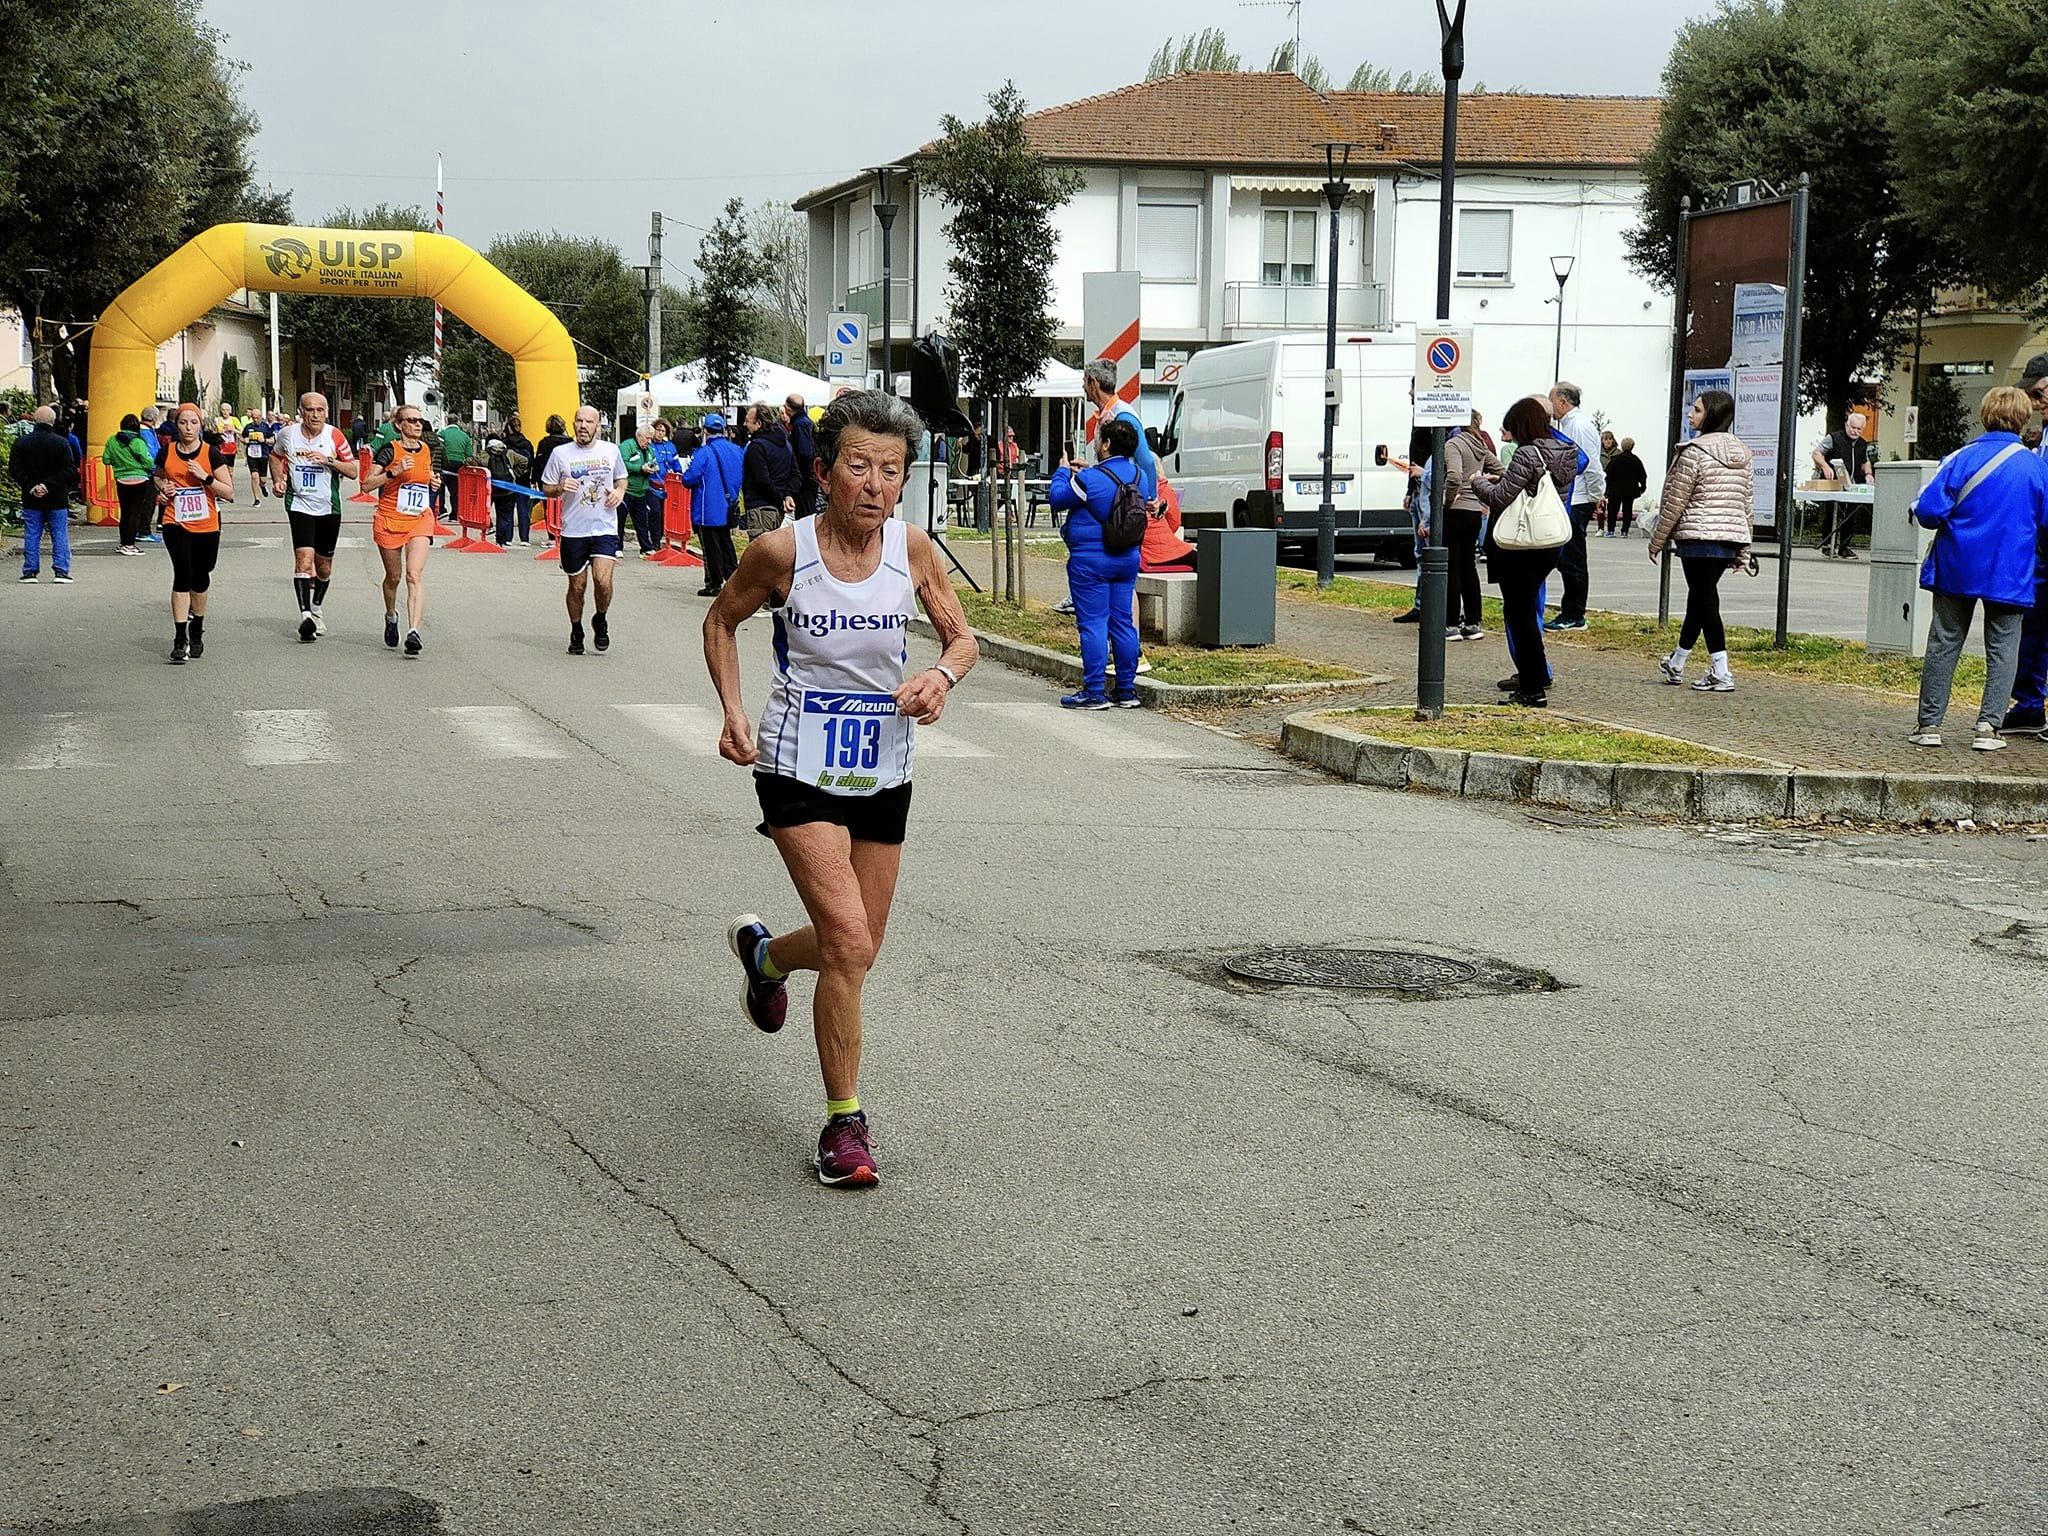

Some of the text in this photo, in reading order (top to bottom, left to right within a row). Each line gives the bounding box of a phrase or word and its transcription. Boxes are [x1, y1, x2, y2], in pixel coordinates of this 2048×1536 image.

[319, 239, 403, 269] UISP
[319, 268, 404, 280] UNIONE ITALIANA
[319, 277, 398, 288] SPORT PER TUTTI
[1738, 391, 1779, 403] NARDI NATALIA
[302, 472, 316, 488] 80
[179, 495, 202, 513] 288
[407, 491, 424, 508] 112
[823, 717, 881, 769] 193
